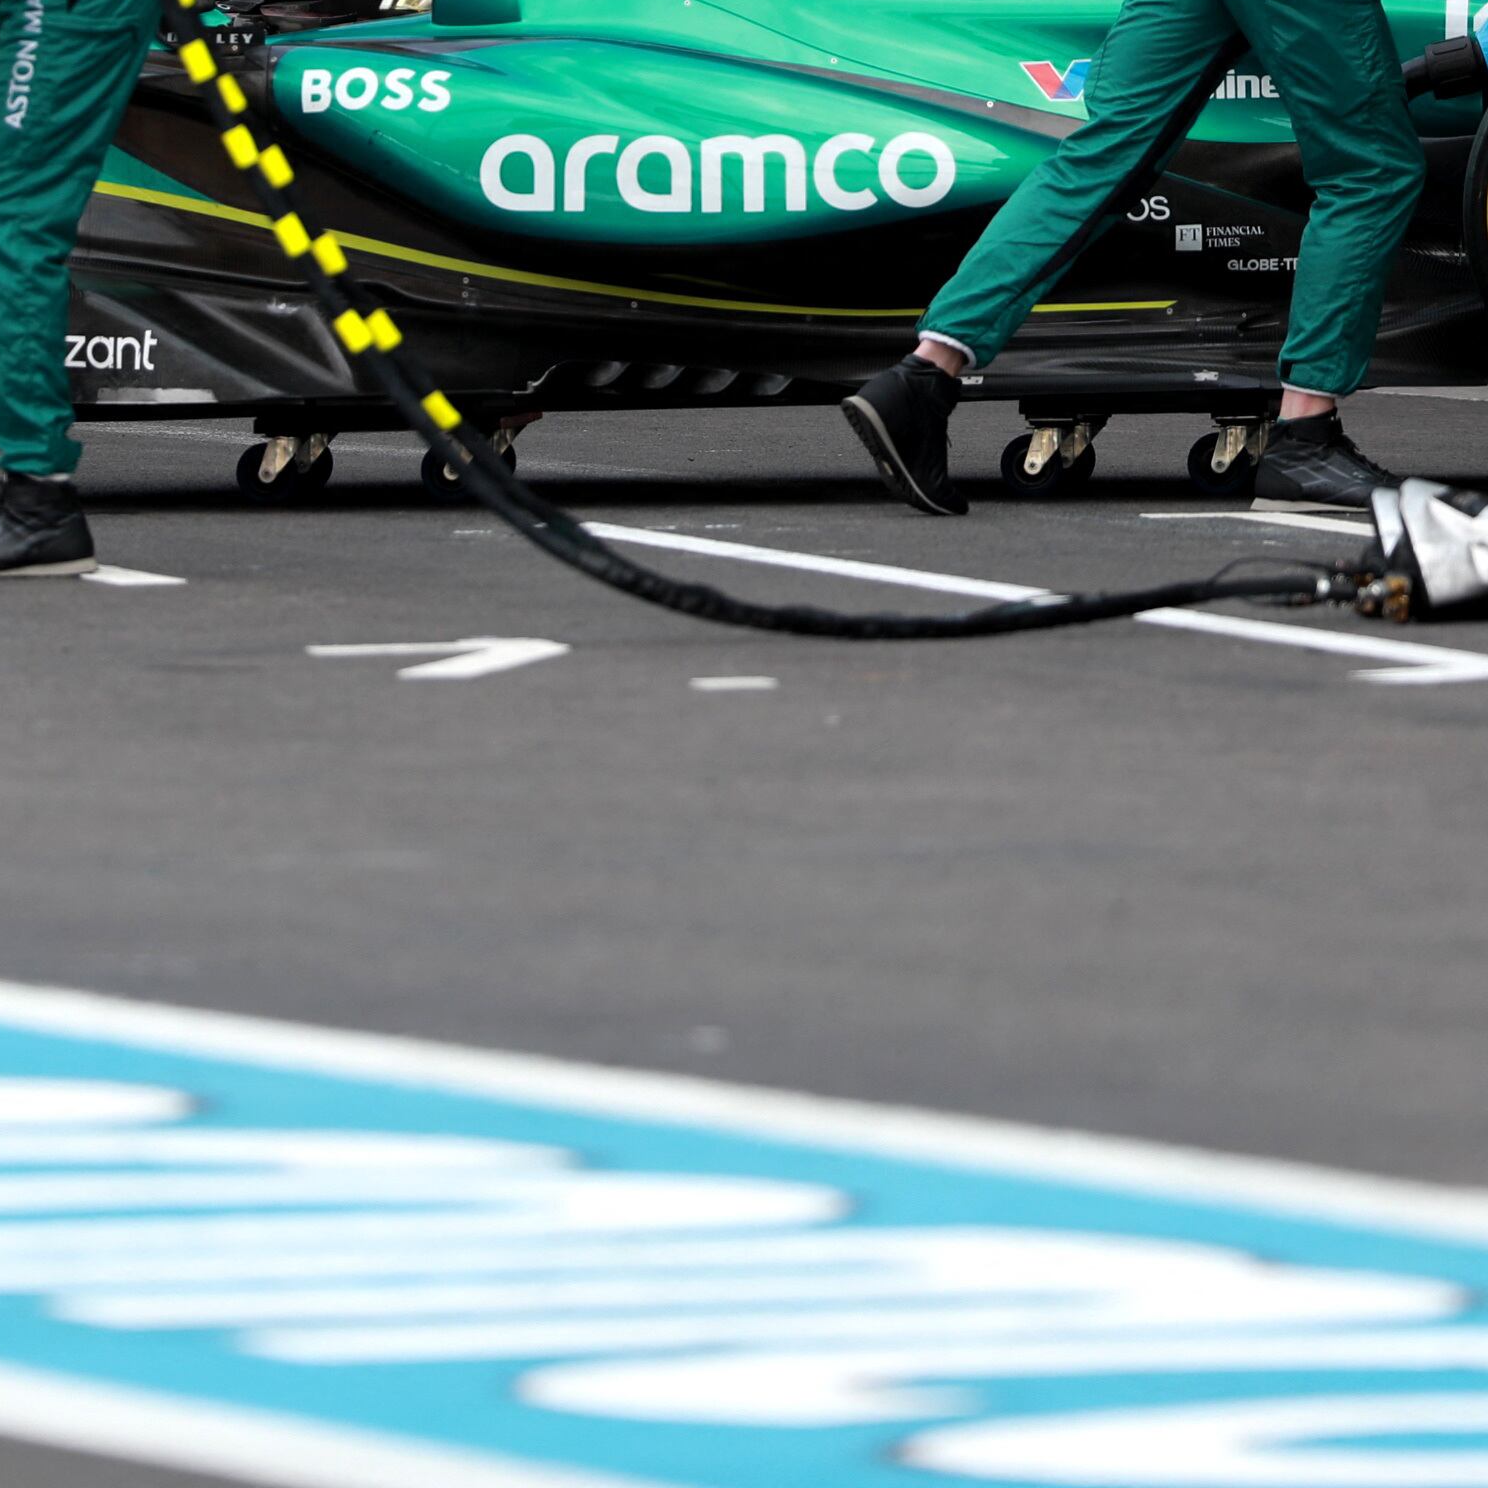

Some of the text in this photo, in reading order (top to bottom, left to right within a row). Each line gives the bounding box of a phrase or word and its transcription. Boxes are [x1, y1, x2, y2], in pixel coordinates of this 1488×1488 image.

[4, 40, 39, 129] ASTON
[300, 67, 453, 113] BOSS
[479, 132, 956, 213] aramco
[1178, 227, 1201, 242] FT
[1206, 226, 1264, 237] FINANCIAL
[1206, 237, 1240, 248] TIMES
